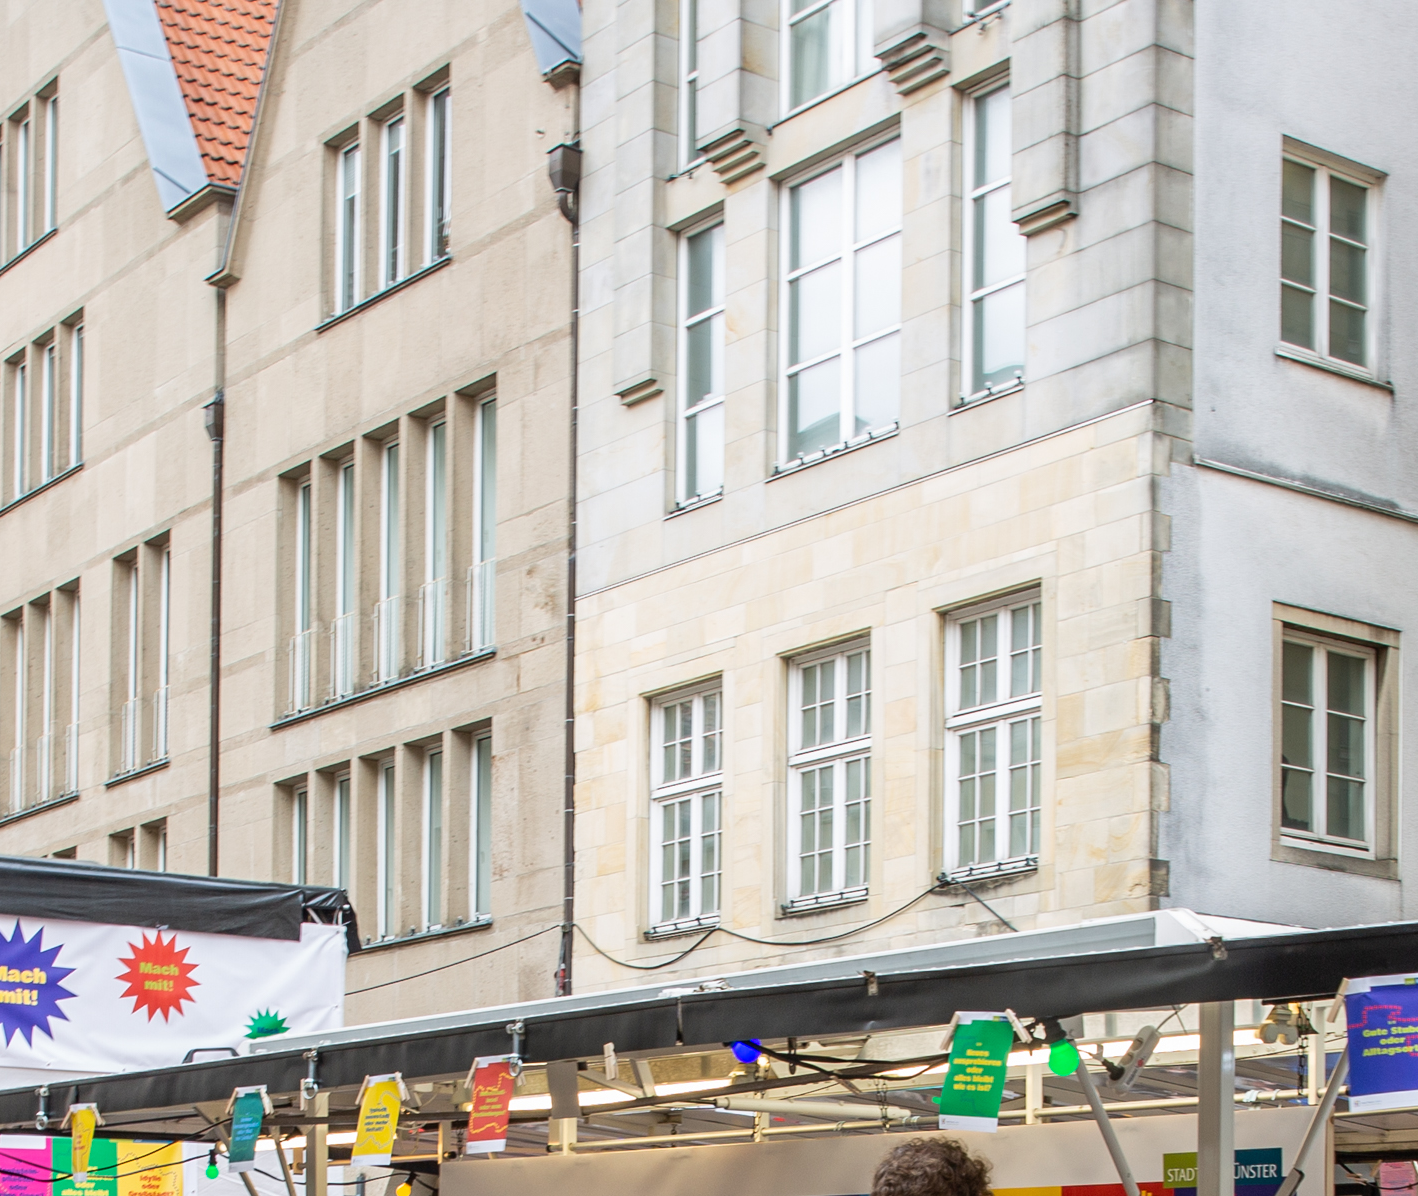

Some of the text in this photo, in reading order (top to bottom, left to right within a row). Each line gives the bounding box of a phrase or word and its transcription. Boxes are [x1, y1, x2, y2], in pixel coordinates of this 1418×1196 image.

[139, 962, 180, 977] Mach
[144, 979, 174, 992] mit!
[1363, 1029, 1388, 1037] Gute
[1380, 1037, 1406, 1045] oder
[1234, 1163, 1278, 1178] ÜNSTER
